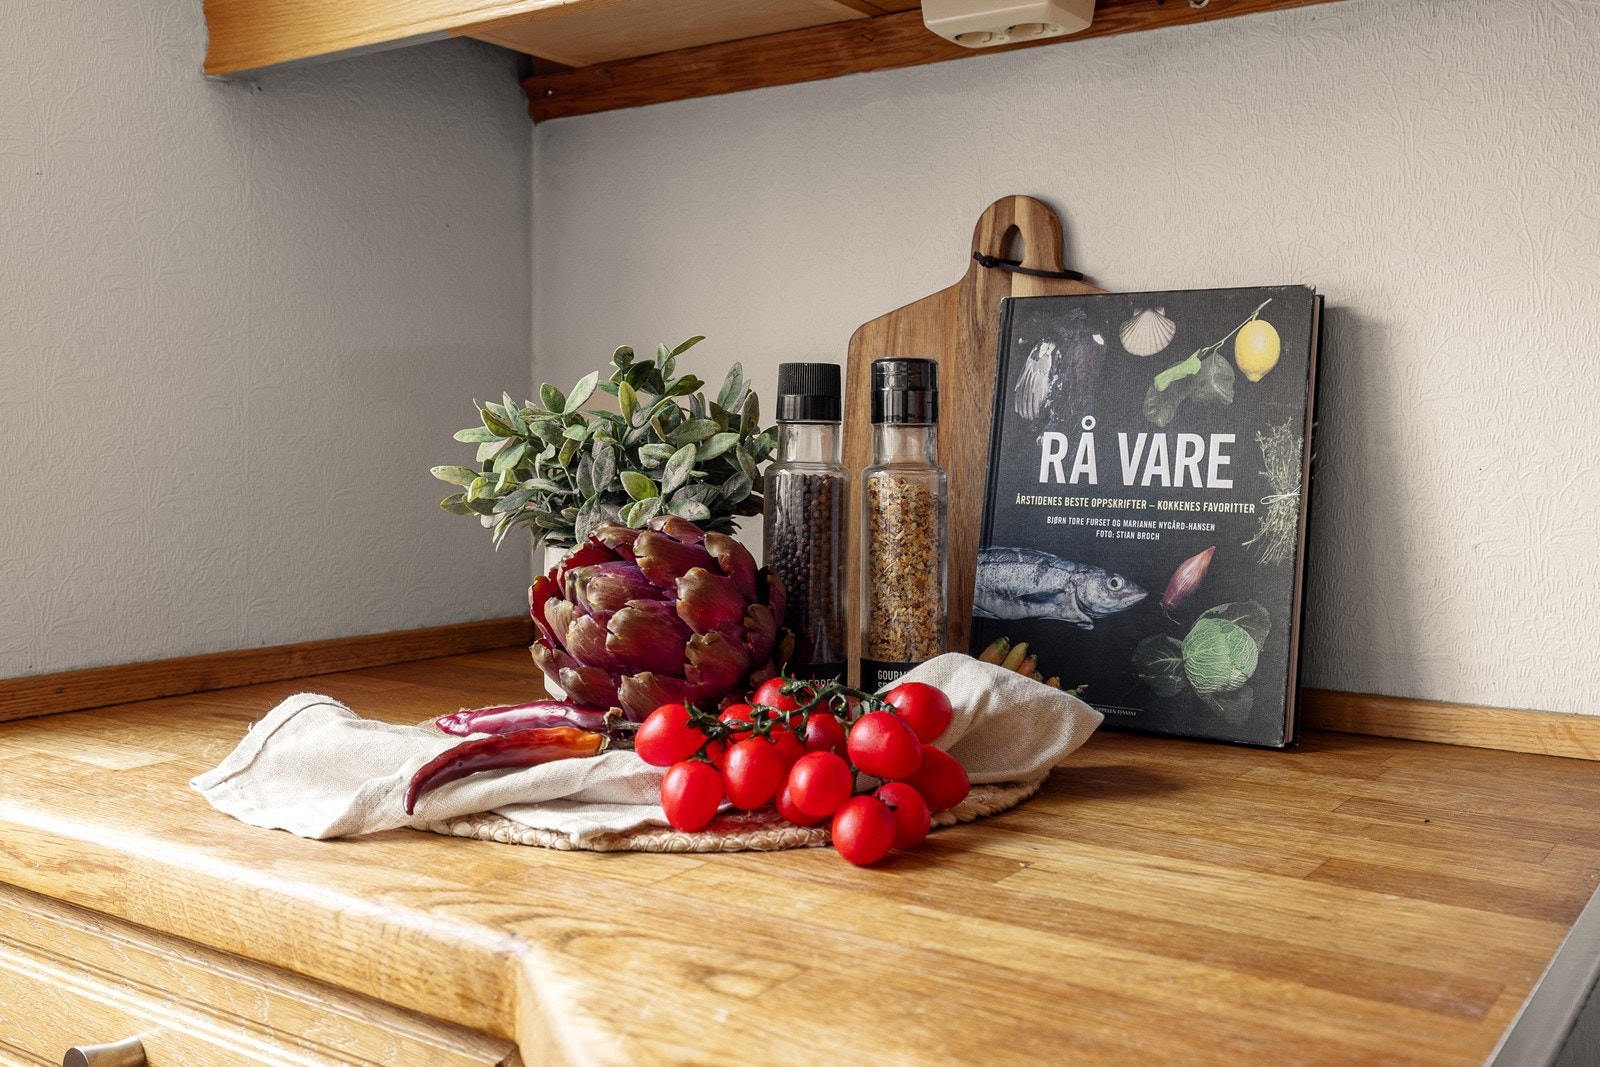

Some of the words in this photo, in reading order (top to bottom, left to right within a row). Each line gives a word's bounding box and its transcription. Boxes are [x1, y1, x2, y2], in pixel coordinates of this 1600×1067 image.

[1039, 415, 1098, 485] RÅ
[1118, 432, 1236, 489] VARE
[1015, 492, 1063, 506] ÅRSTIDENES
[1064, 496, 1089, 508] BESTE
[1091, 498, 1147, 510] OPPSKRIFTER
[1157, 500, 1201, 512] KOKKENES
[1203, 502, 1255, 514] FAVORITTER
[1047, 516, 1067, 525] BJØRN
[1069, 517, 1084, 526] TORE
[1086, 518, 1110, 527] FURSET
[1112, 519, 1121, 527] OG
[1123, 520, 1157, 529] MARIANNE
[1159, 520, 1215, 532] NYGÅRD-HANSEN
[1096, 530, 1115, 538] FOTO:
[1116, 531, 1135, 539] STIAN
[1137, 532, 1160, 540] BROCH
